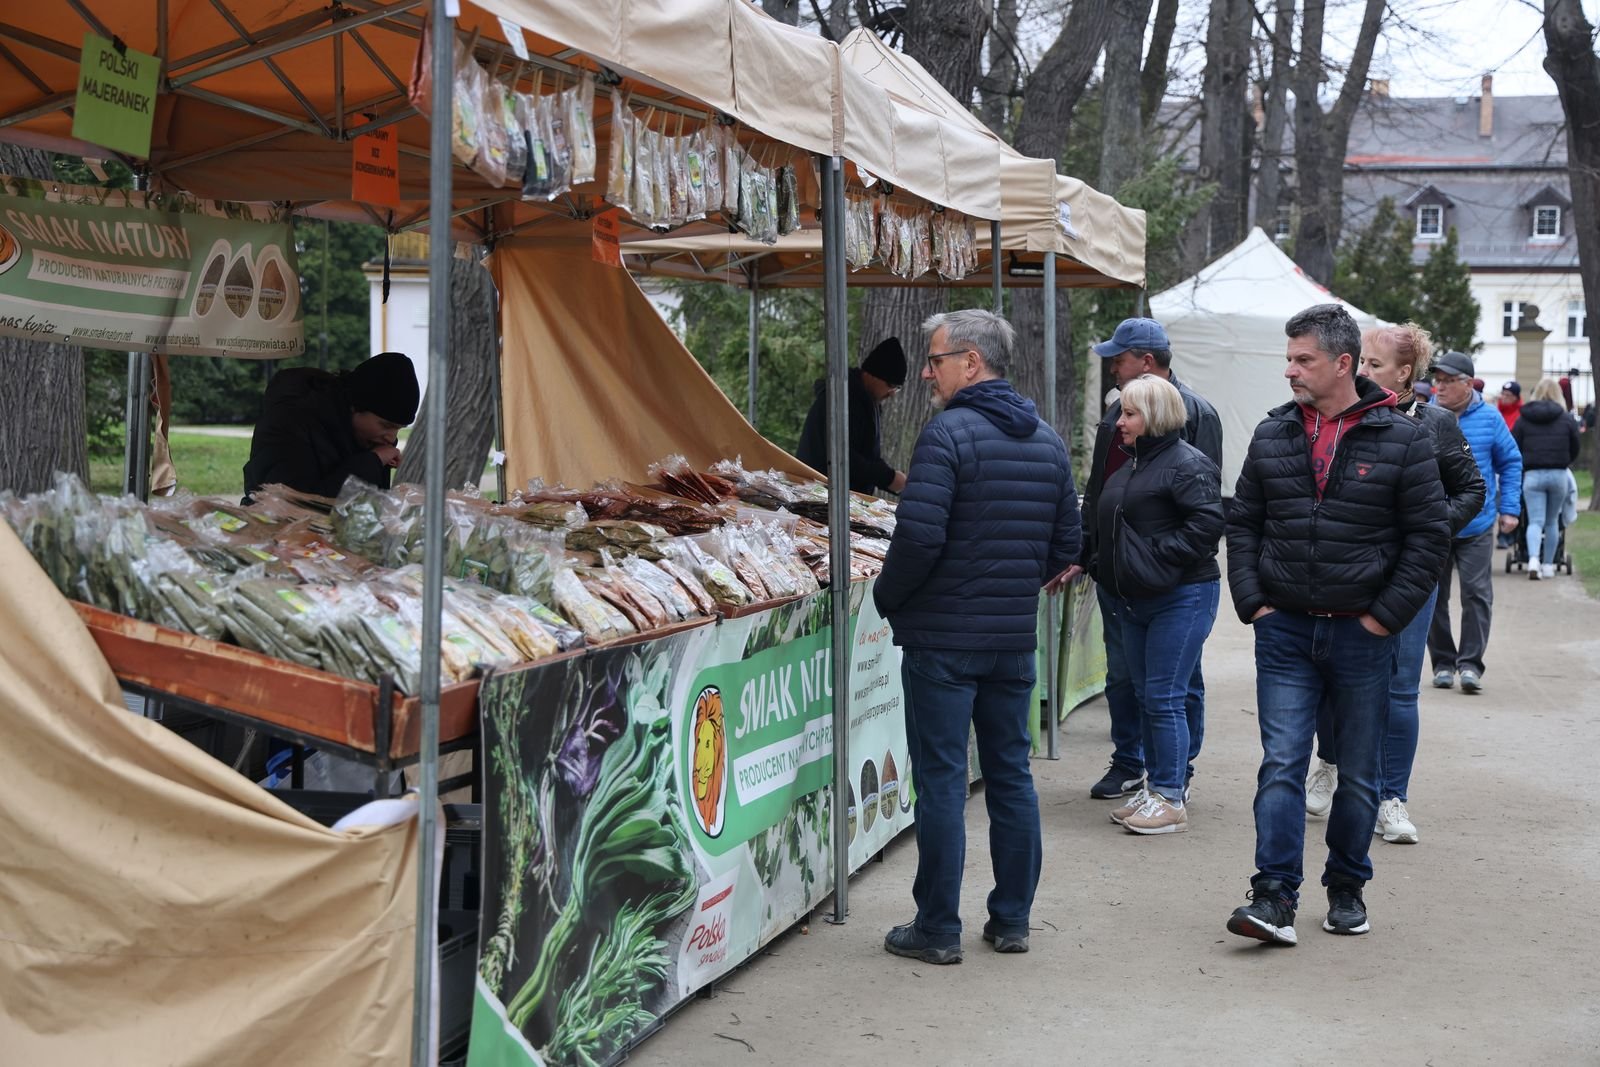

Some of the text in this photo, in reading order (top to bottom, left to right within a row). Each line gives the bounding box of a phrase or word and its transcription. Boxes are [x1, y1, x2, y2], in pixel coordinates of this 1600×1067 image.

[99, 50, 139, 80] POLSKI
[82, 75, 151, 114] MAJERANEK
[6, 208, 192, 260] SMAK NATURY
[38, 257, 185, 291] PRODUCENT NATURALNYCH PRZYPRAW
[735, 664, 797, 739] SMAK
[739, 753, 787, 791] PRODUCENT
[686, 912, 726, 954] Polska
